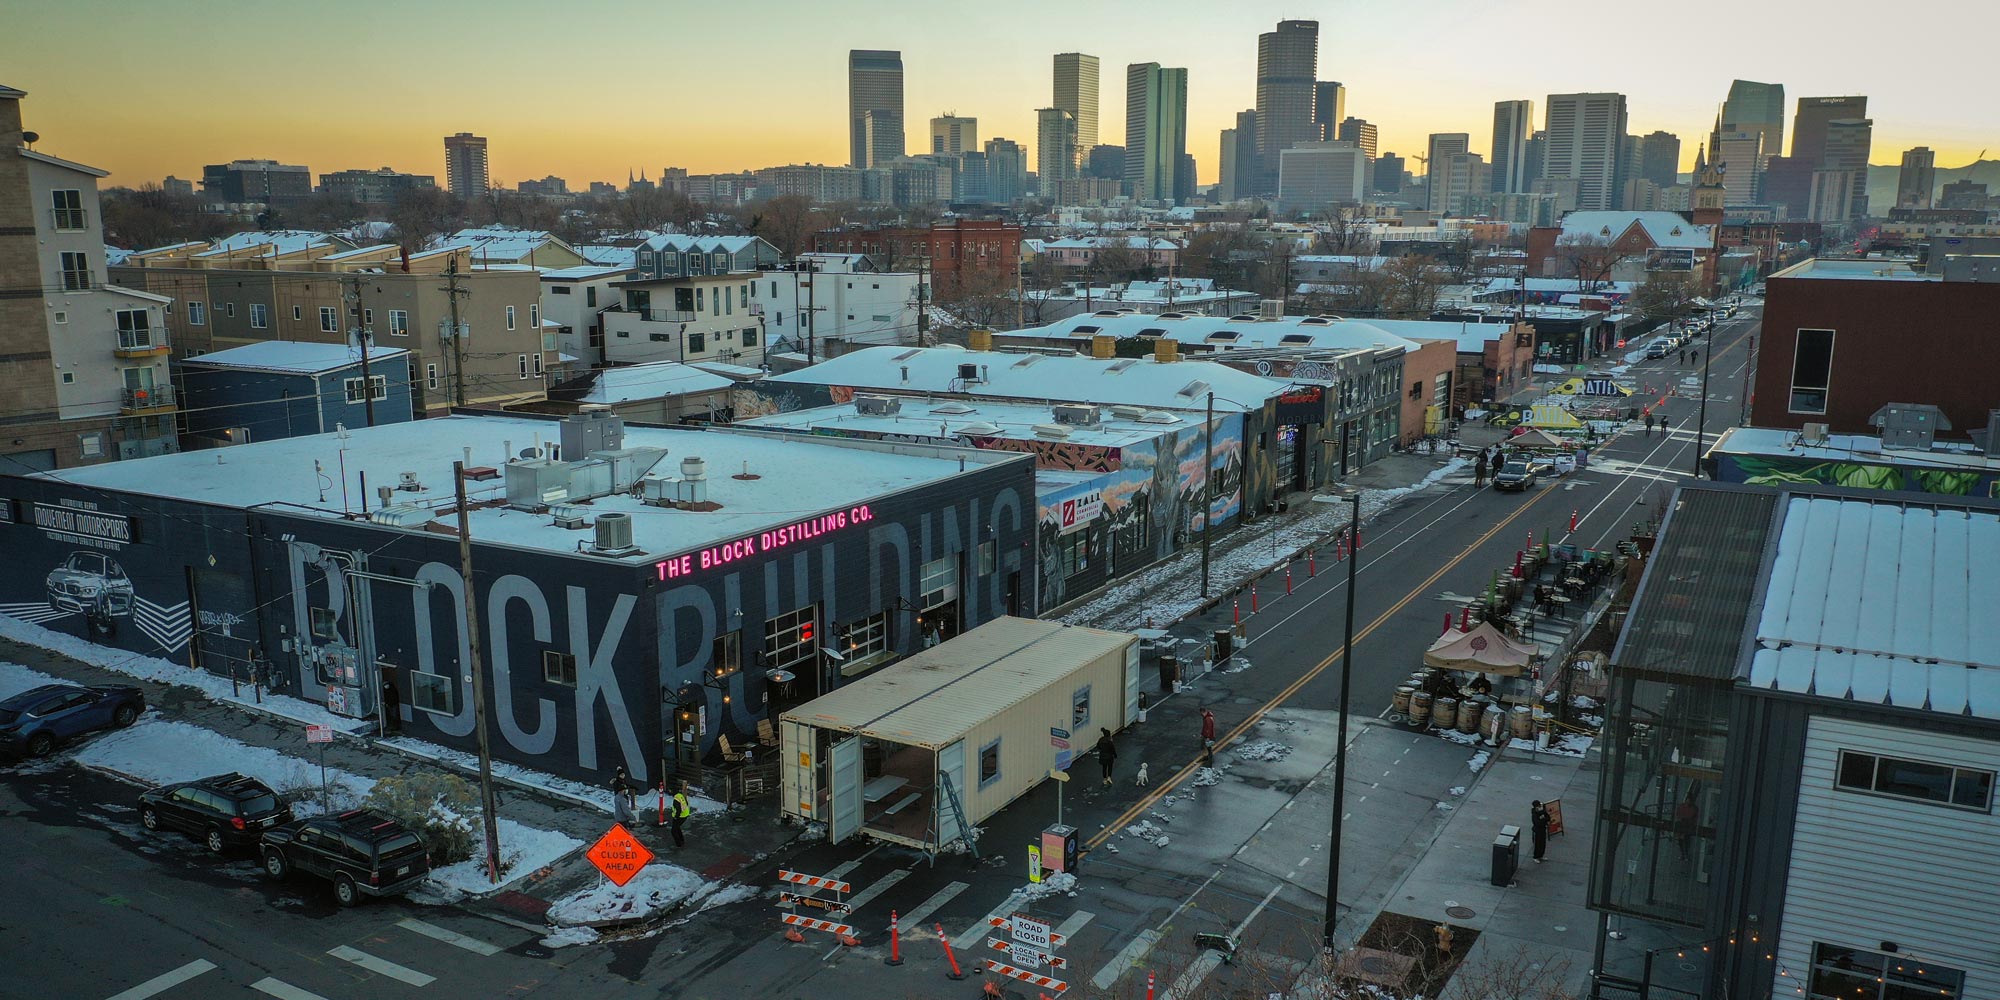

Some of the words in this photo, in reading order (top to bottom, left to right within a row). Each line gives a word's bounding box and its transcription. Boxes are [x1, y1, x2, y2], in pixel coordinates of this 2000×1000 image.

[1077, 493, 1101, 507] ZALL
[34, 507, 75, 531] MOVEMENT
[76, 514, 129, 541] MOTORSPORTS
[655, 555, 692, 581] THE
[701, 537, 754, 570] BLOCK
[761, 511, 847, 551] DISTILLING
[850, 504, 873, 524] CO.
[605, 840, 632, 849] ROAD
[600, 850, 638, 860] CLOSED
[605, 863, 635, 871] AHEAD
[1018, 921, 1043, 934] ROAD
[1014, 929, 1046, 944] CLOSED
[1015, 947, 1036, 956] LOCAL
[1016, 955, 1035, 965] OPEN
